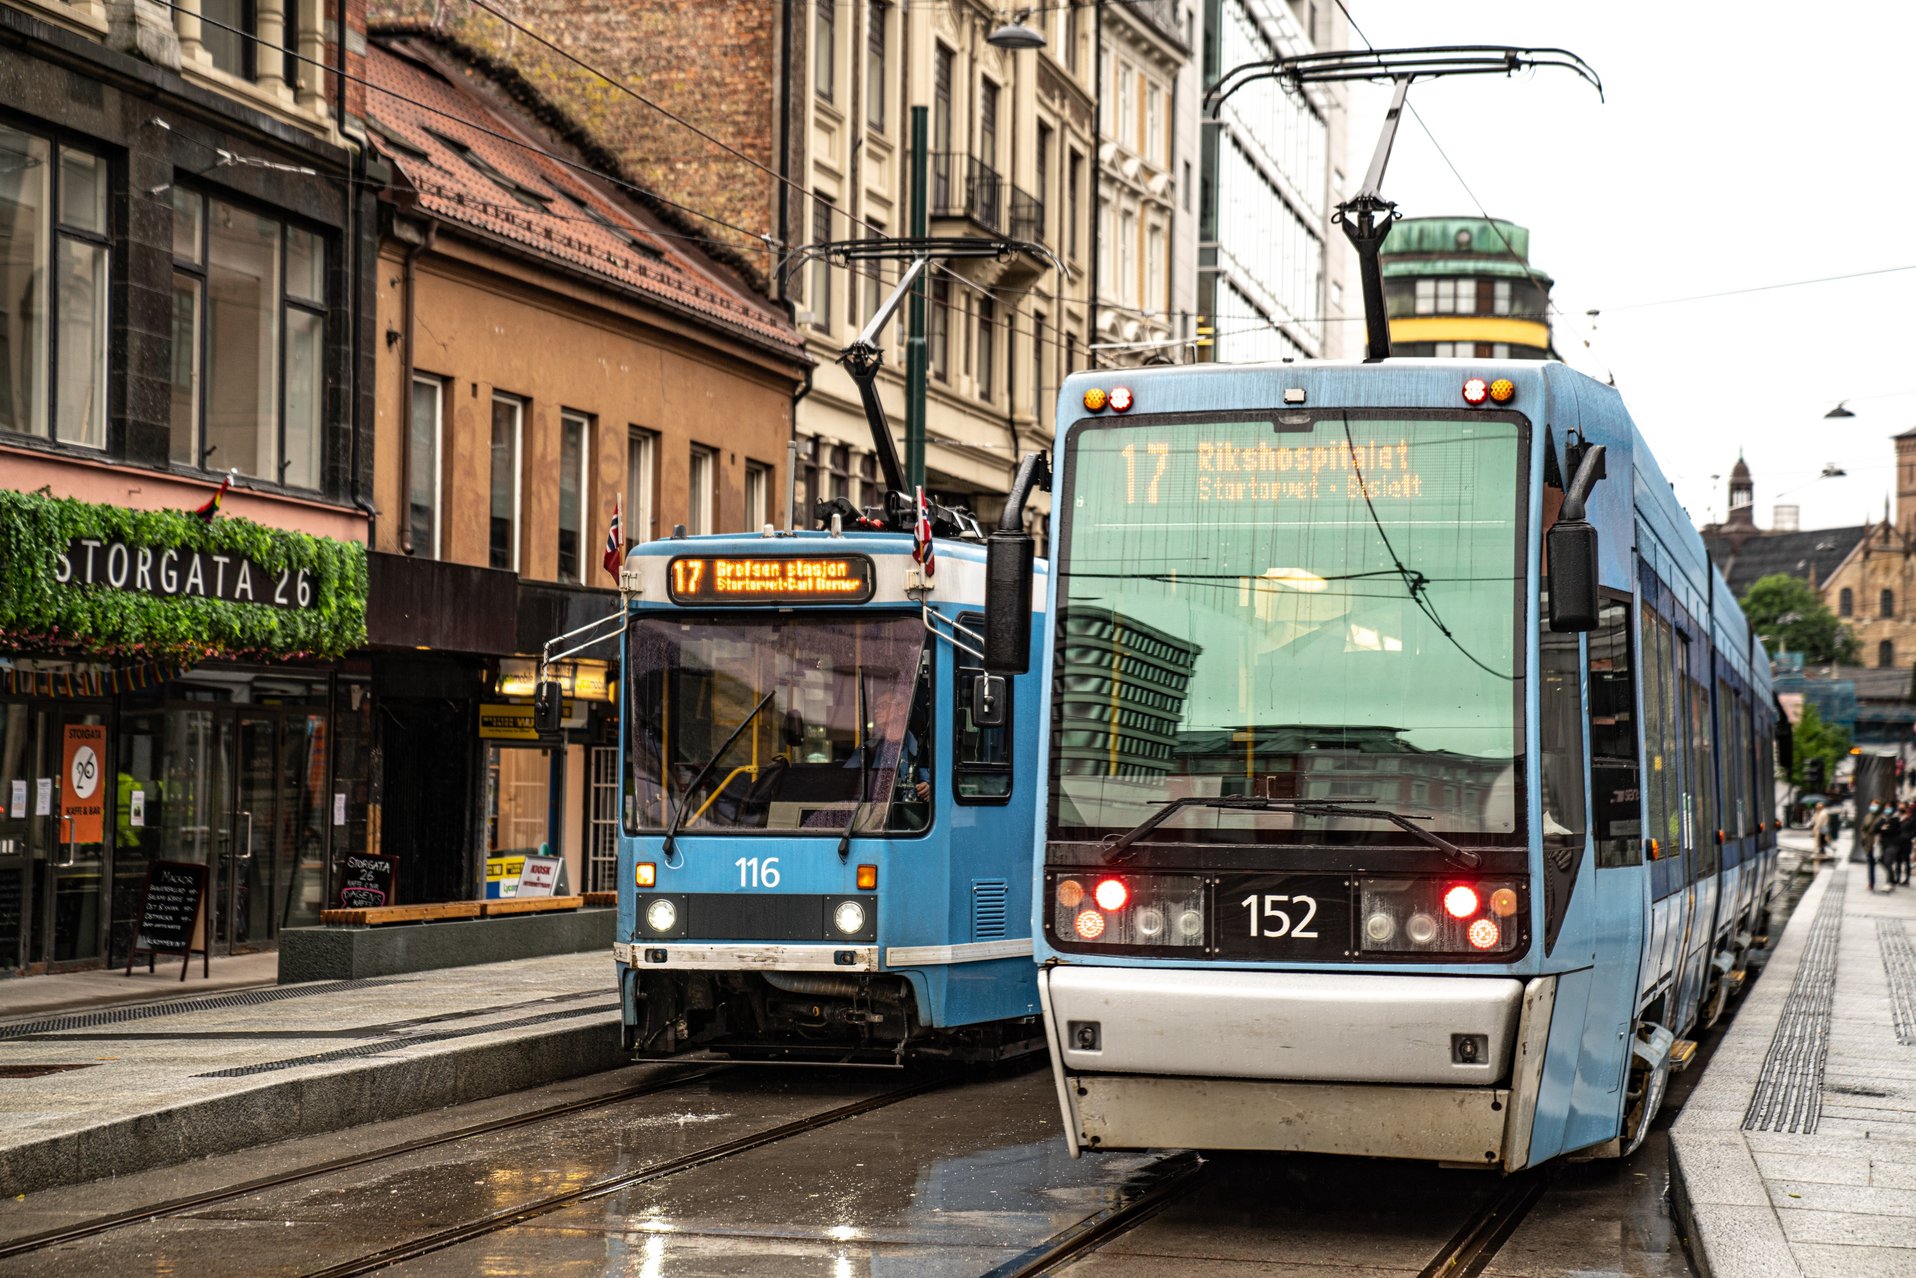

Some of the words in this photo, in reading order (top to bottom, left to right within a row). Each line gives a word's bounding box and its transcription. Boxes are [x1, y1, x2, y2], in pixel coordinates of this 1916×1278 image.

[1122, 443, 1168, 504] 17
[1199, 439, 1409, 473] Rikshospitalet
[1199, 475, 1319, 501] Stortorvet
[1346, 473, 1423, 499] Bislett
[55, 538, 254, 602] STORGATA
[273, 566, 311, 608] 26
[673, 560, 703, 593] 17
[715, 560, 780, 577] Grefsen
[786, 560, 847, 578] stasjon
[815, 577, 861, 592] Berner
[76, 751, 95, 790] 26
[347, 856, 390, 874] STORGATA
[359, 869, 375, 882] 26
[530, 864, 551, 876] KIOSK
[735, 857, 781, 888] 116
[1241, 894, 1319, 938] 152
